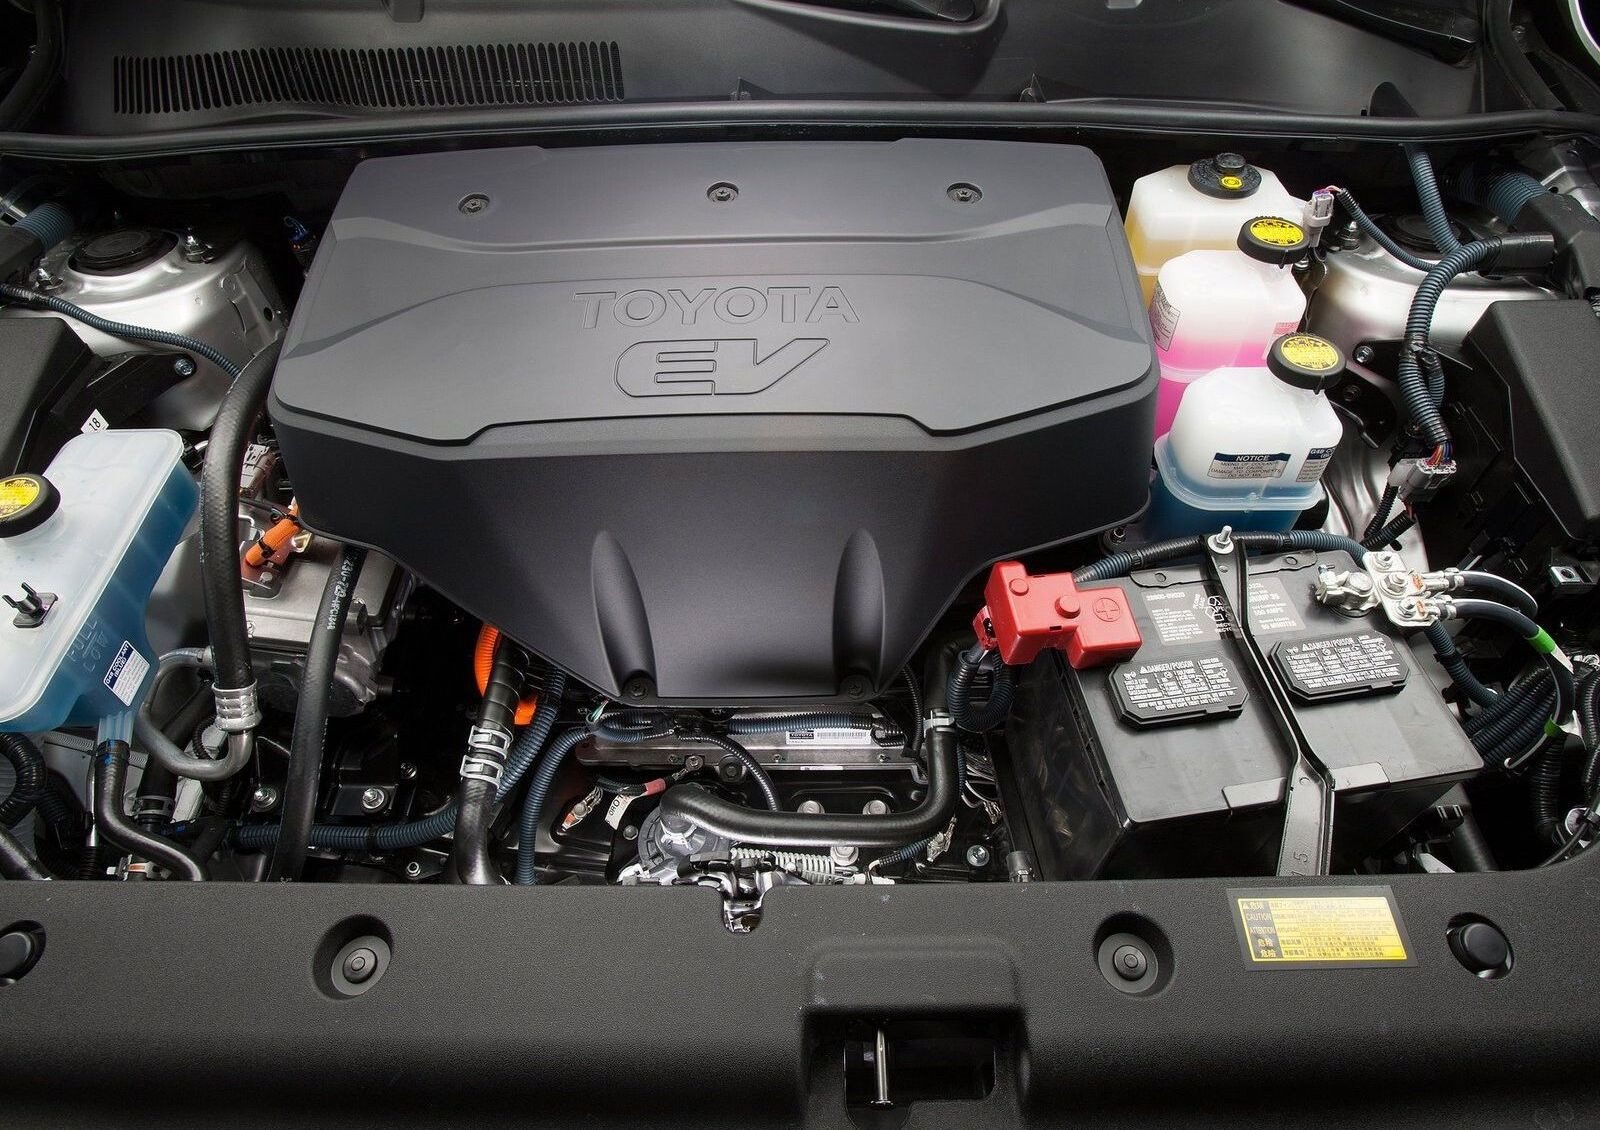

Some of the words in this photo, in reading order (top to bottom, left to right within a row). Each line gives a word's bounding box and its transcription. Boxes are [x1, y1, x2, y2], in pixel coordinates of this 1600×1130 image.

[574, 285, 861, 330] TOYOTA
[614, 337, 831, 398] EV
[88, 416, 101, 431] 18
[112, 643, 129, 671] COOLANT
[1246, 912, 1272, 921] CAUTION
[1249, 926, 1275, 935] ATTENTION
